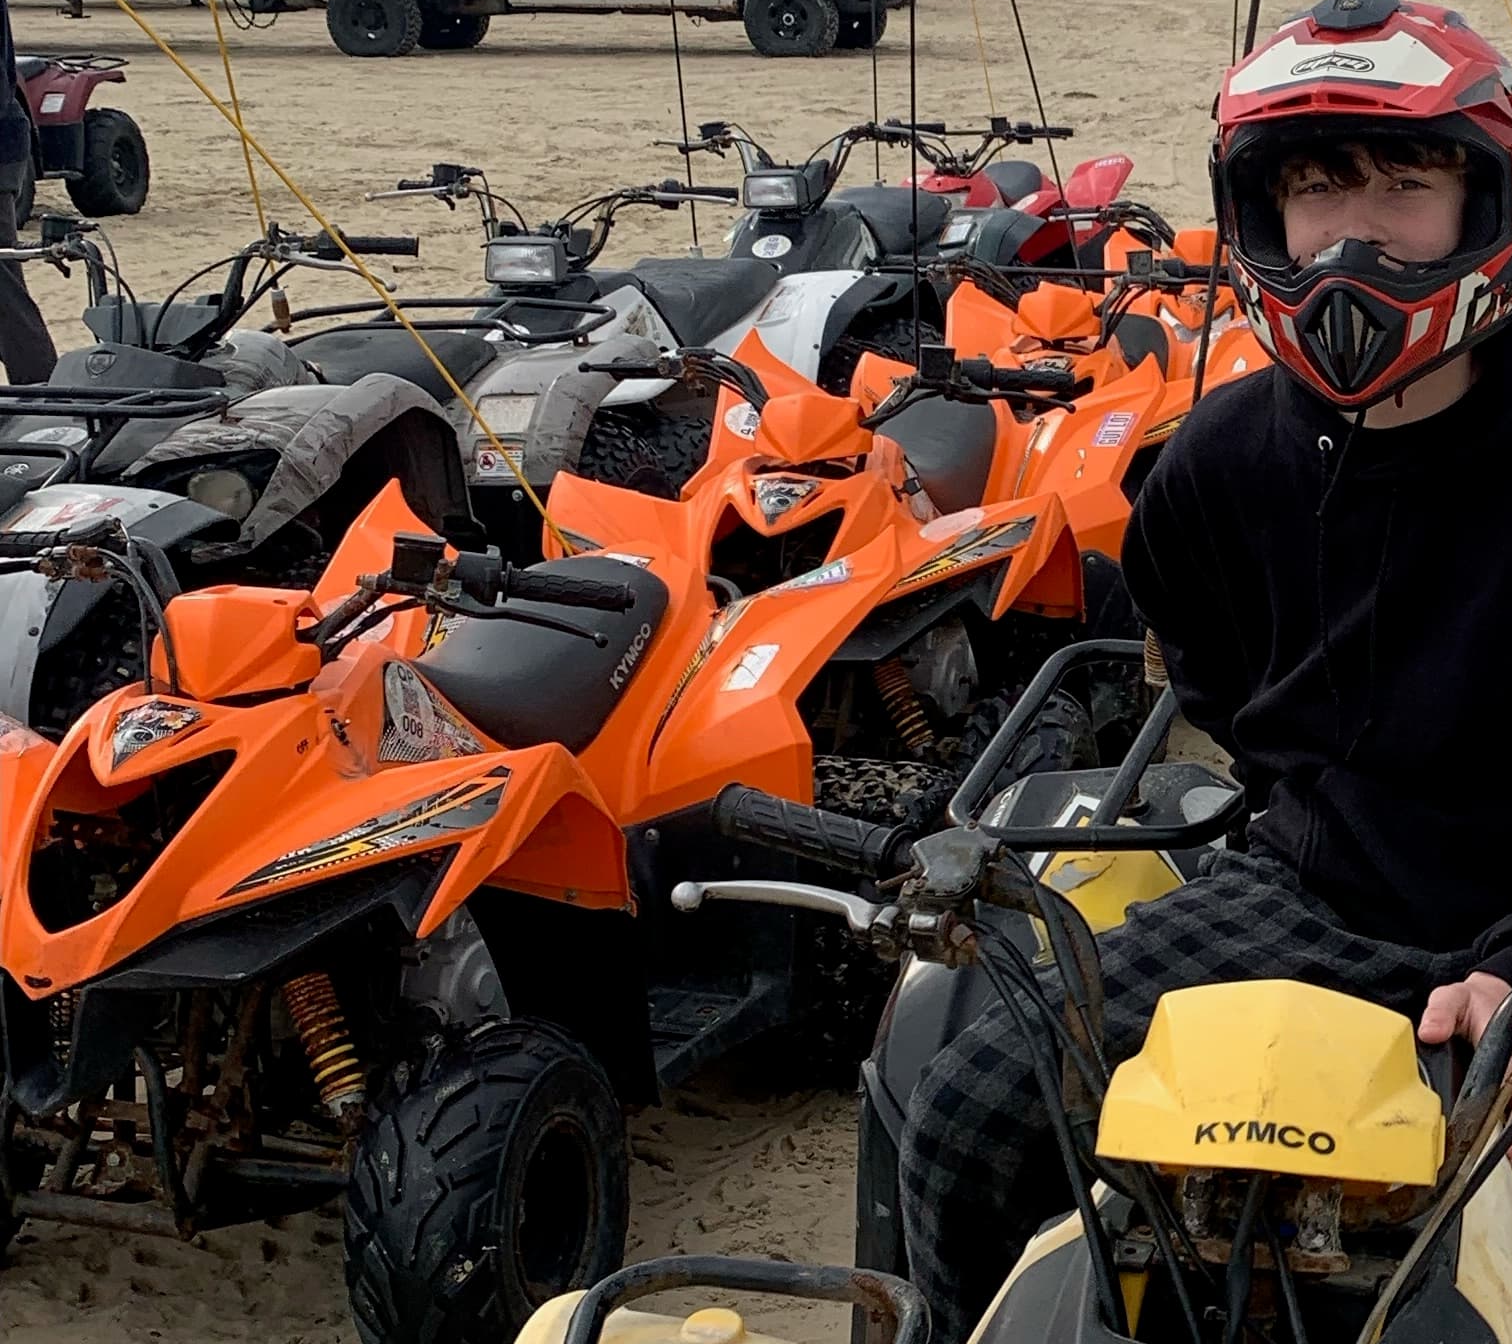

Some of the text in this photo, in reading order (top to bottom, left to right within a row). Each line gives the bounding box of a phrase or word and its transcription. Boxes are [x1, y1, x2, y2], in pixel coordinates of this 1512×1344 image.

[609, 623, 651, 690] KYMCO
[402, 715, 424, 739] 008
[1194, 1120, 1336, 1156] KYMCO
